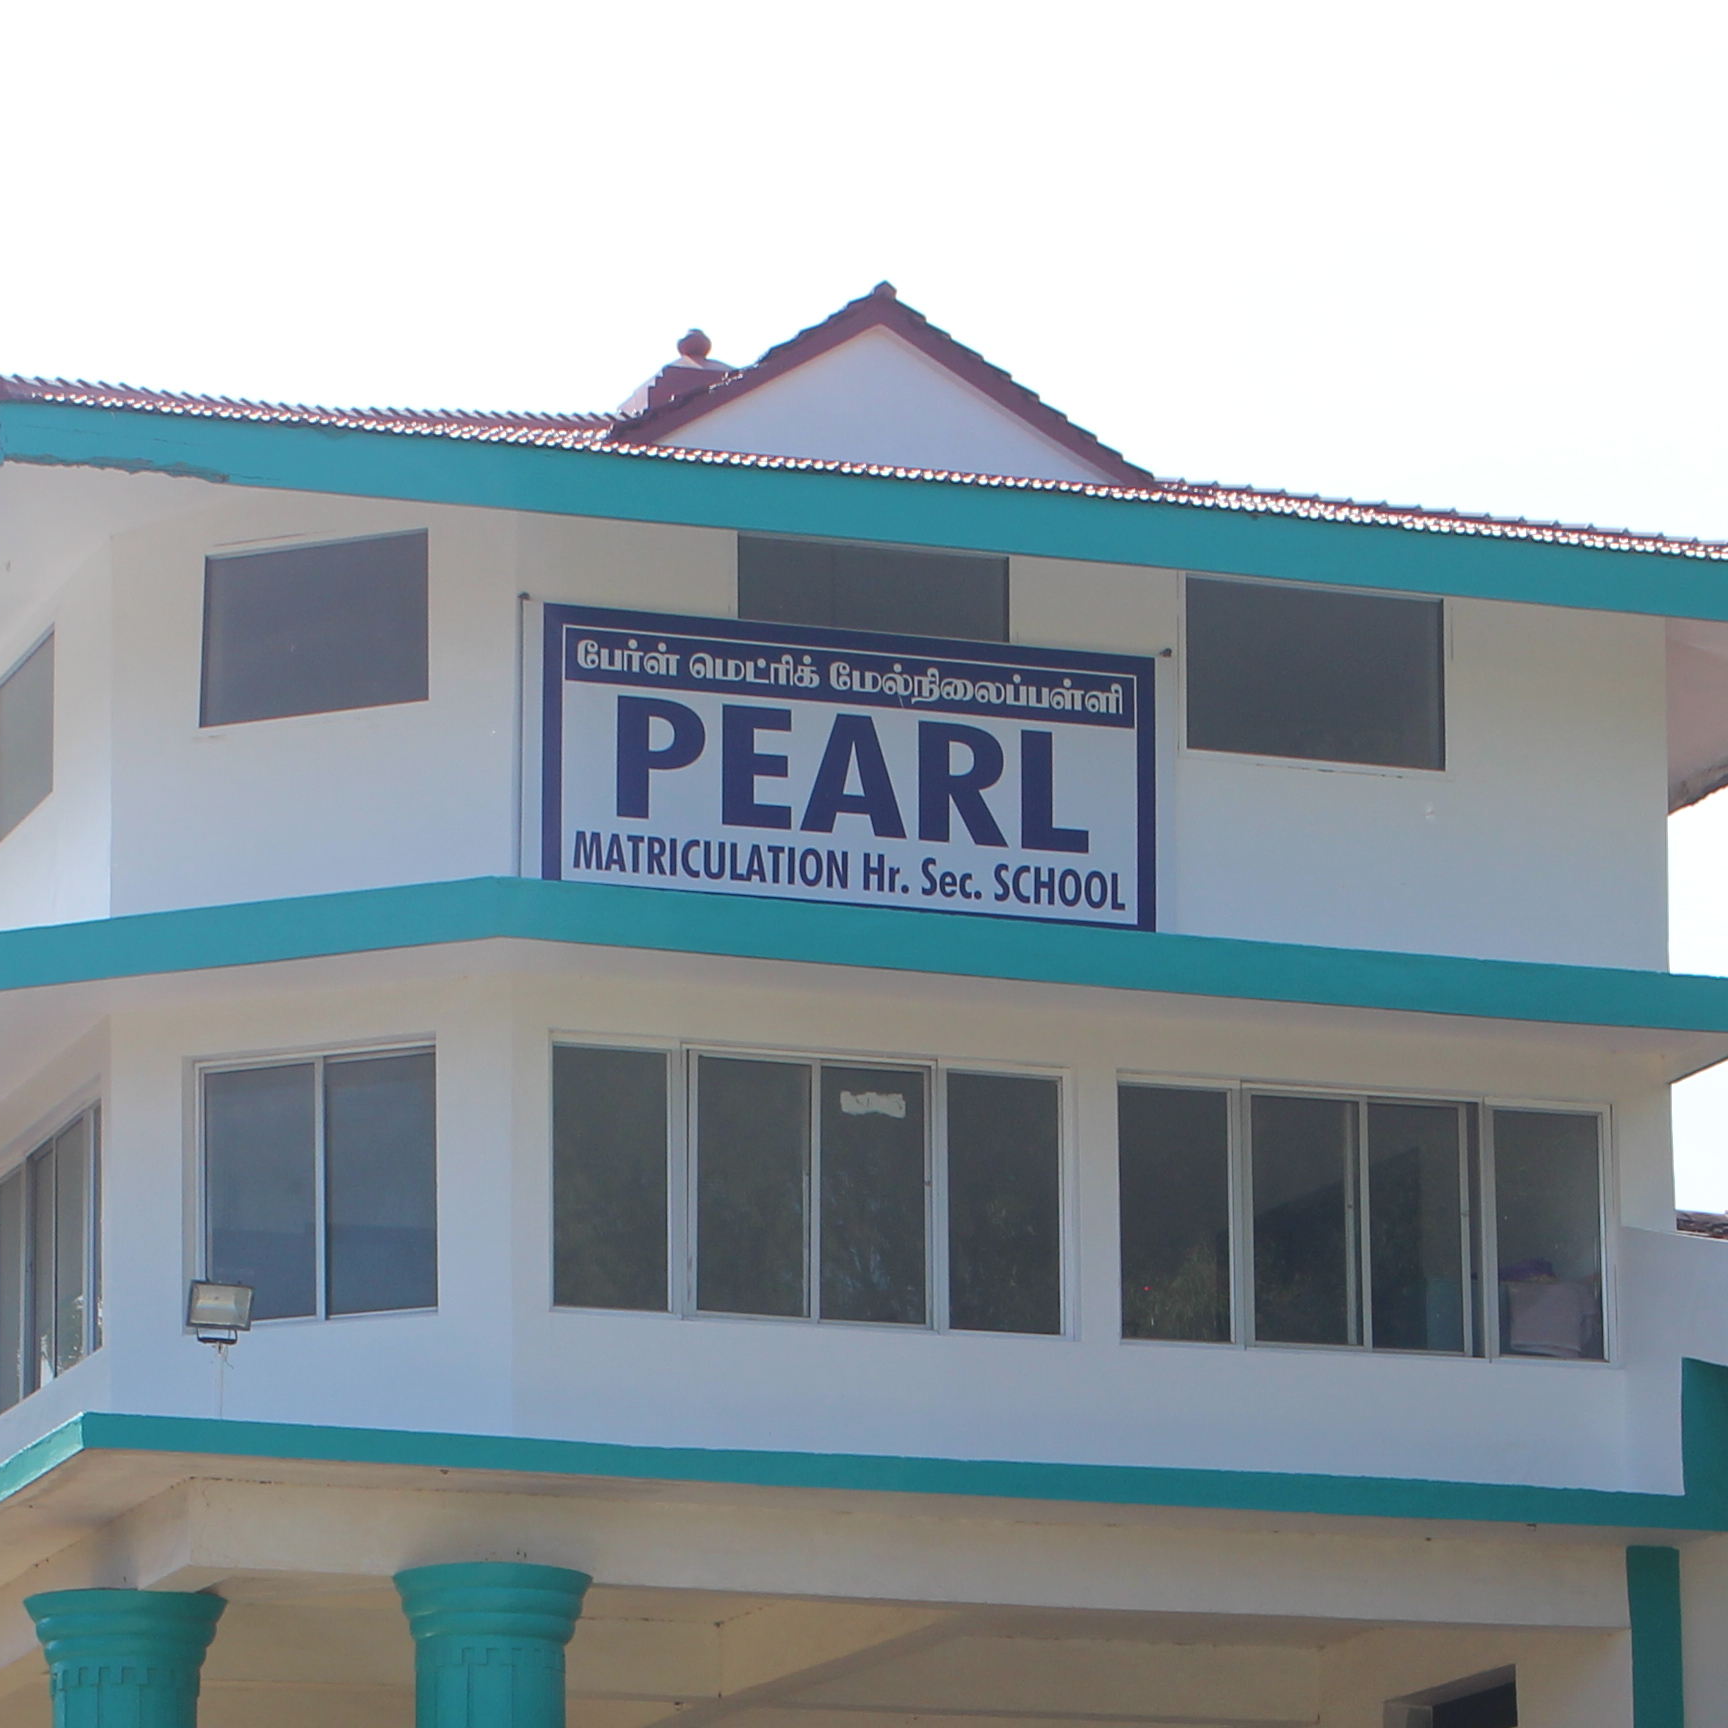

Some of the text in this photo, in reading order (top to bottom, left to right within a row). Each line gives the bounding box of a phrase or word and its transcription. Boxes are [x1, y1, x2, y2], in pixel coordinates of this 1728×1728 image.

[576, 638, 1123, 715] பேர்ள் மெட்ரிக் மேல்நிலைப்பள்ளி
[617, 694, 1089, 854] PEARL
[573, 830, 1126, 911] MATRICULATION Hr. Sec. SCHOOL
